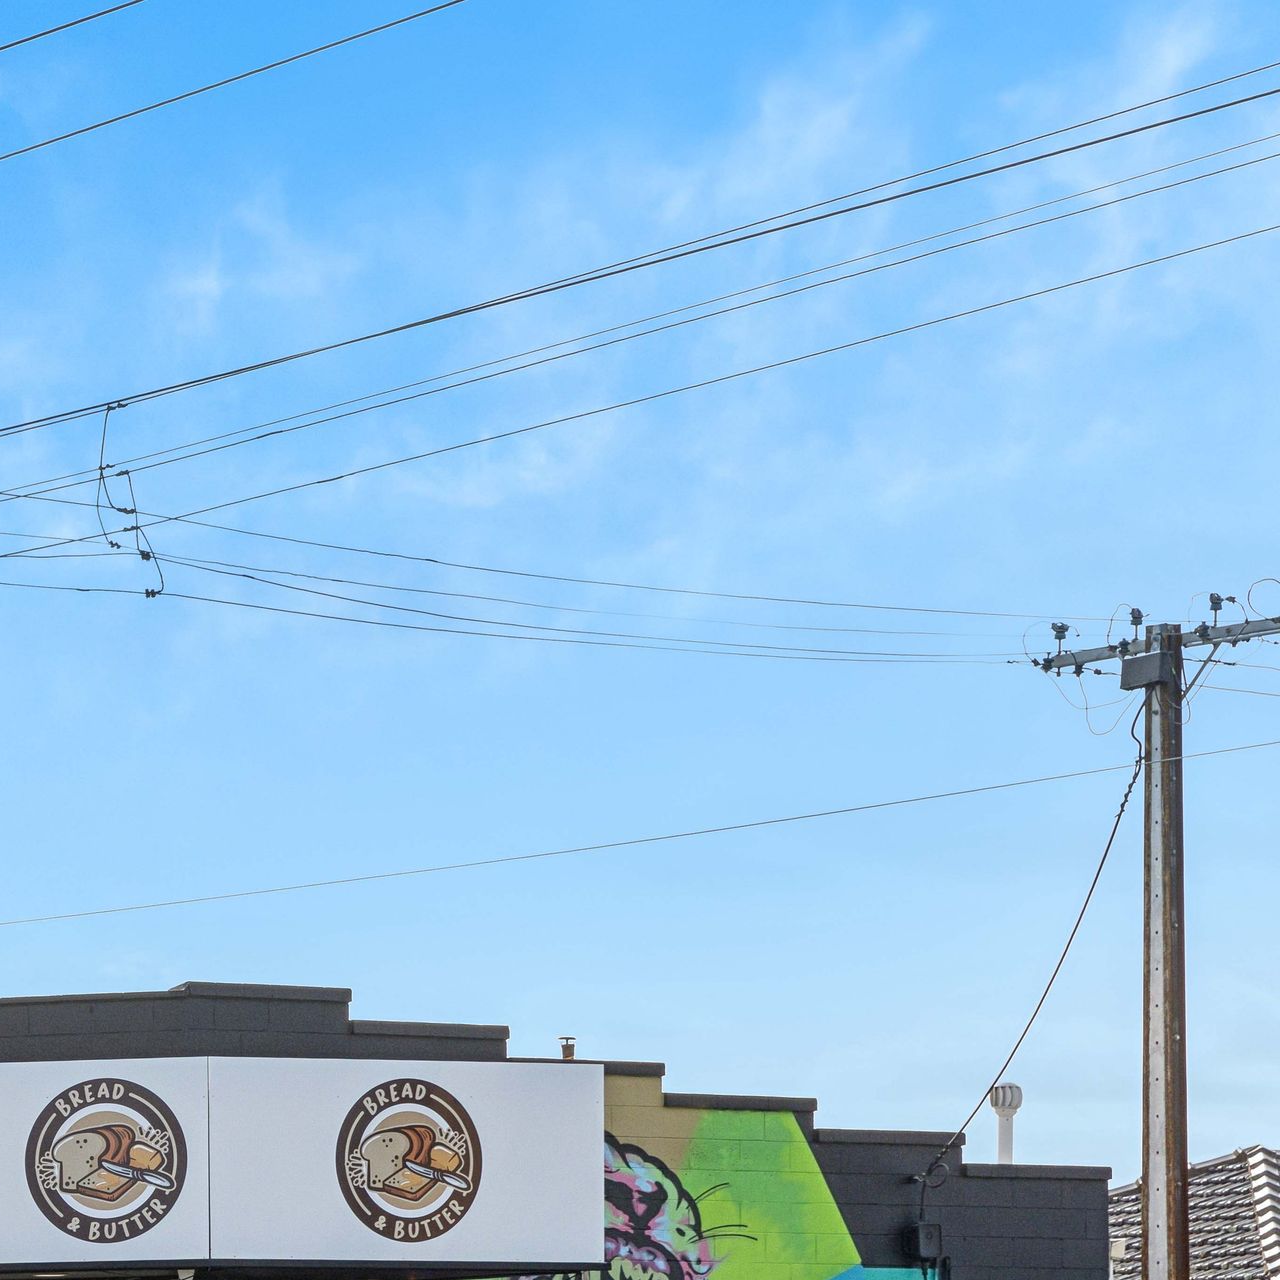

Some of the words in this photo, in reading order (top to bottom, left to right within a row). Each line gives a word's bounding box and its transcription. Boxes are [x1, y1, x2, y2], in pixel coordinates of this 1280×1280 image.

[55, 1082, 125, 1117] BREAD
[363, 1083, 427, 1115] BREAD
[67, 1217, 80, 1232] &
[88, 1199, 167, 1240] BUTTER
[374, 1215, 387, 1231] &
[394, 1199, 465, 1239] BUTTER
